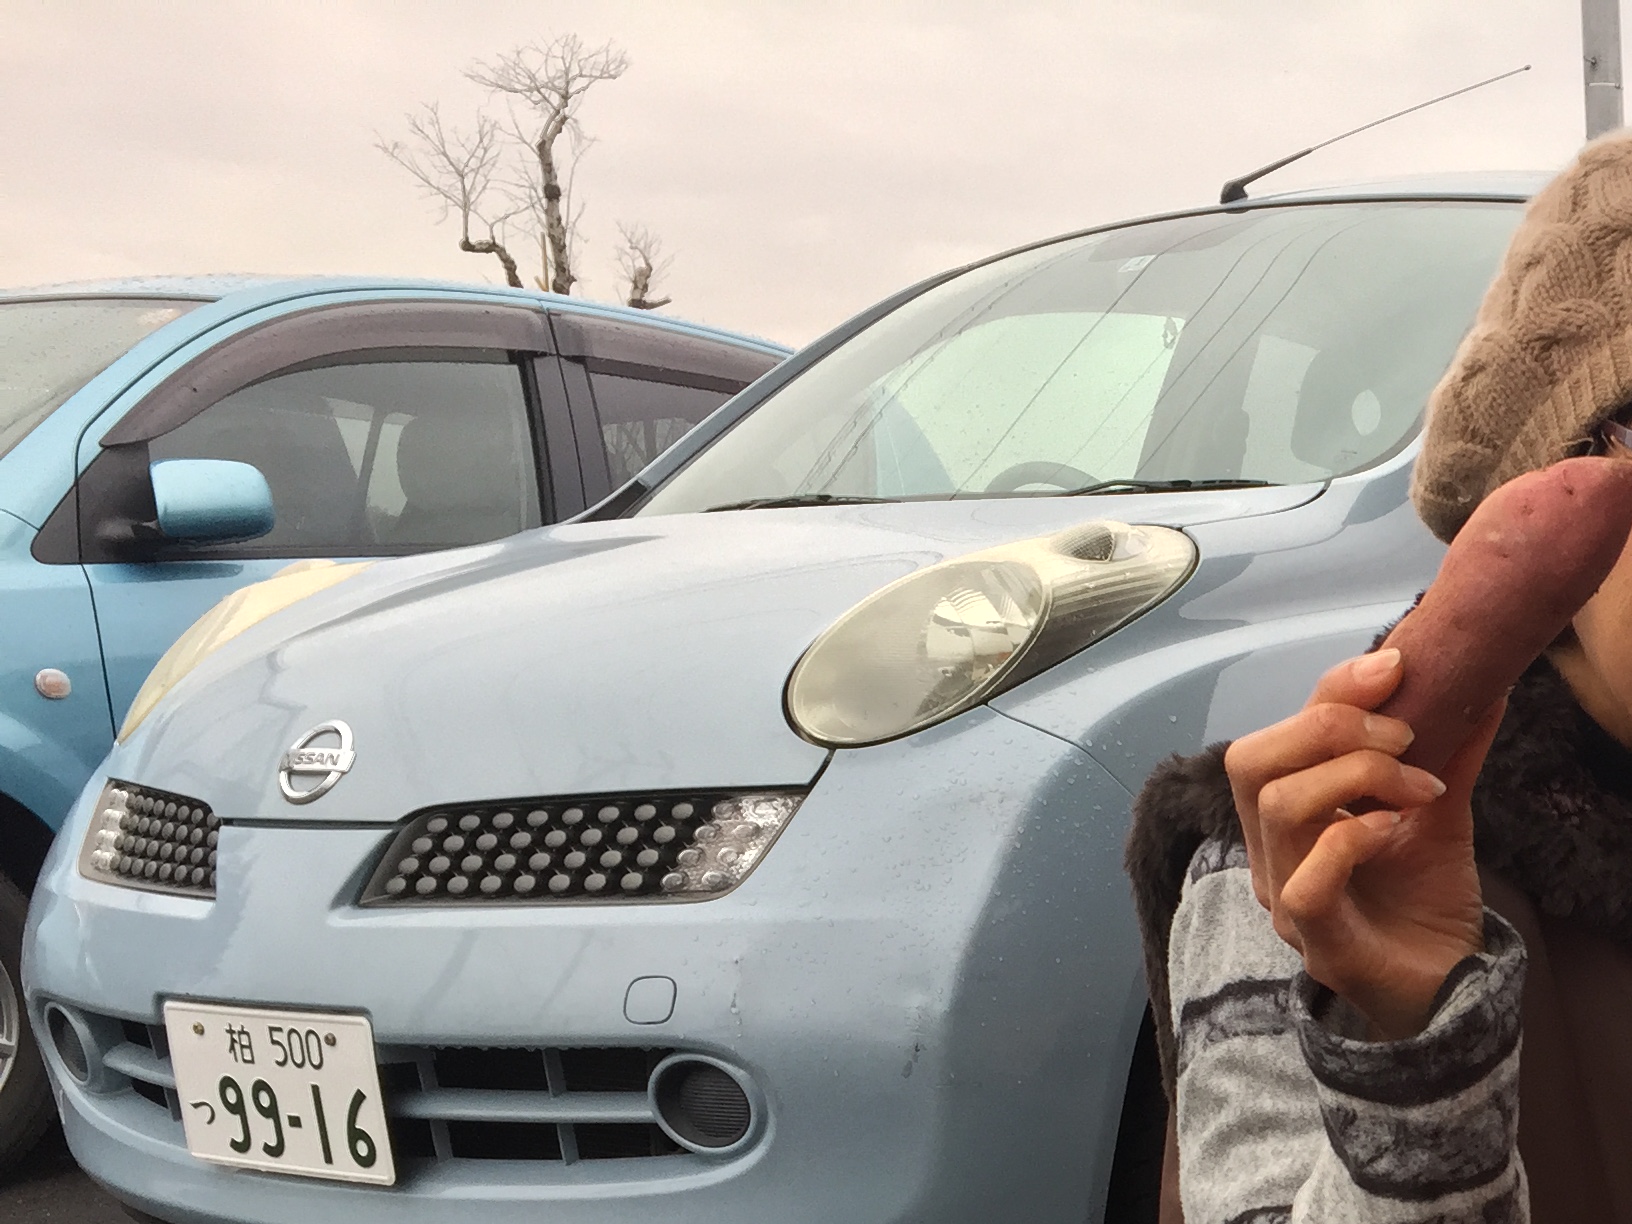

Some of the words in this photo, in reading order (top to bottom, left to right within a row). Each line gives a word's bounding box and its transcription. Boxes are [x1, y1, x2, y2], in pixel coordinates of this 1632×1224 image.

[225, 1022, 256, 1065] 柏
[266, 1024, 325, 1070] 500
[189, 1099, 216, 1126] つ
[217, 1074, 378, 1169] 99-16
